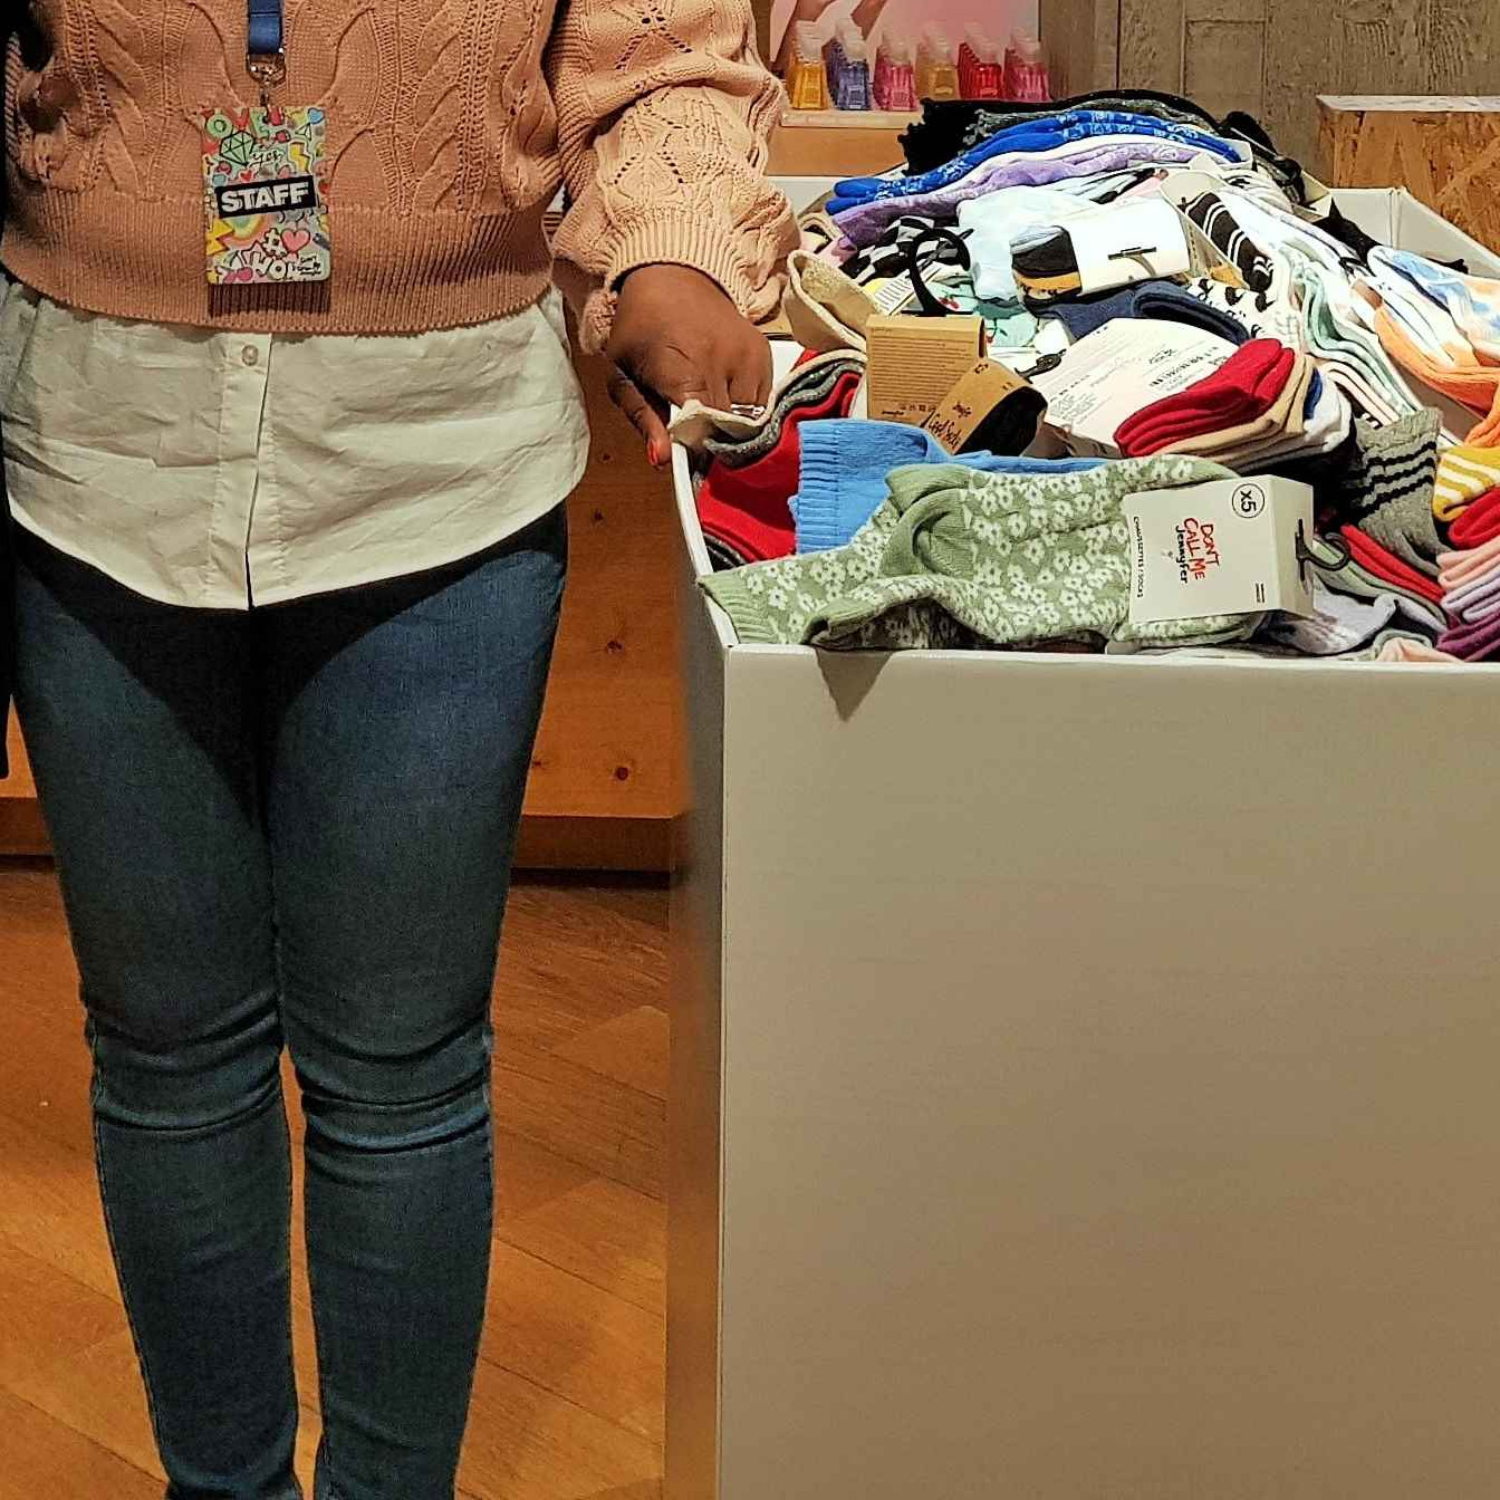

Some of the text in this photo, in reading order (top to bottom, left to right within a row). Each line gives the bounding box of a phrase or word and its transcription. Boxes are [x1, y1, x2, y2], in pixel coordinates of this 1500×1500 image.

[220, 181, 309, 213] STAFF
[1175, 524, 1190, 584] Jennyfer
[1183, 517, 1206, 581] CALL ME
[1200, 523, 1220, 567] DON'T
